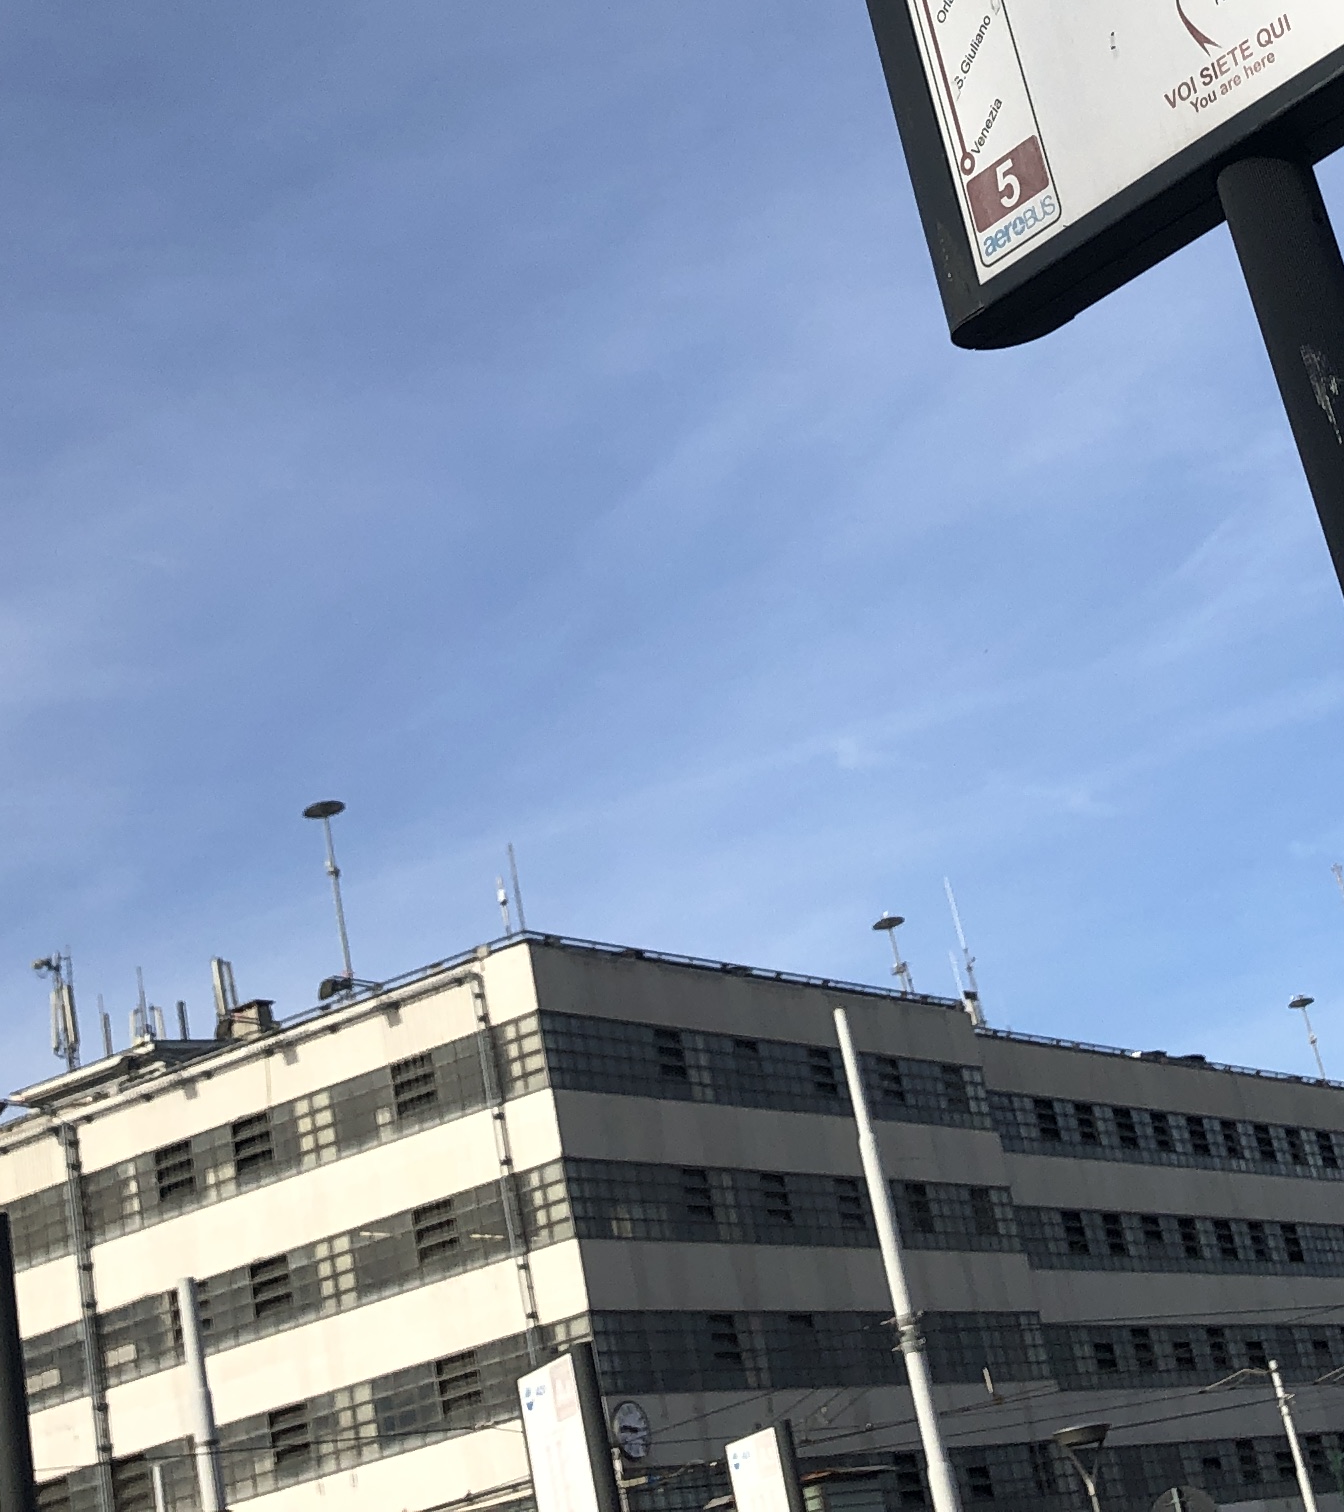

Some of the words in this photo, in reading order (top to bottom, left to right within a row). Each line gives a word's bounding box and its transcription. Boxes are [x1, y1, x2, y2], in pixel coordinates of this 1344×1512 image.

[955, 15, 991, 89] S.Giuliano
[1164, 76, 1198, 109] VOI
[1199, 39, 1254, 86] SIETE
[1256, 13, 1292, 48] QUI
[1190, 89, 1218, 113] You
[1220, 74, 1242, 95] are
[1243, 52, 1276, 79] here
[971, 98, 1003, 155] Venezia
[996, 159, 1021, 208] 5
